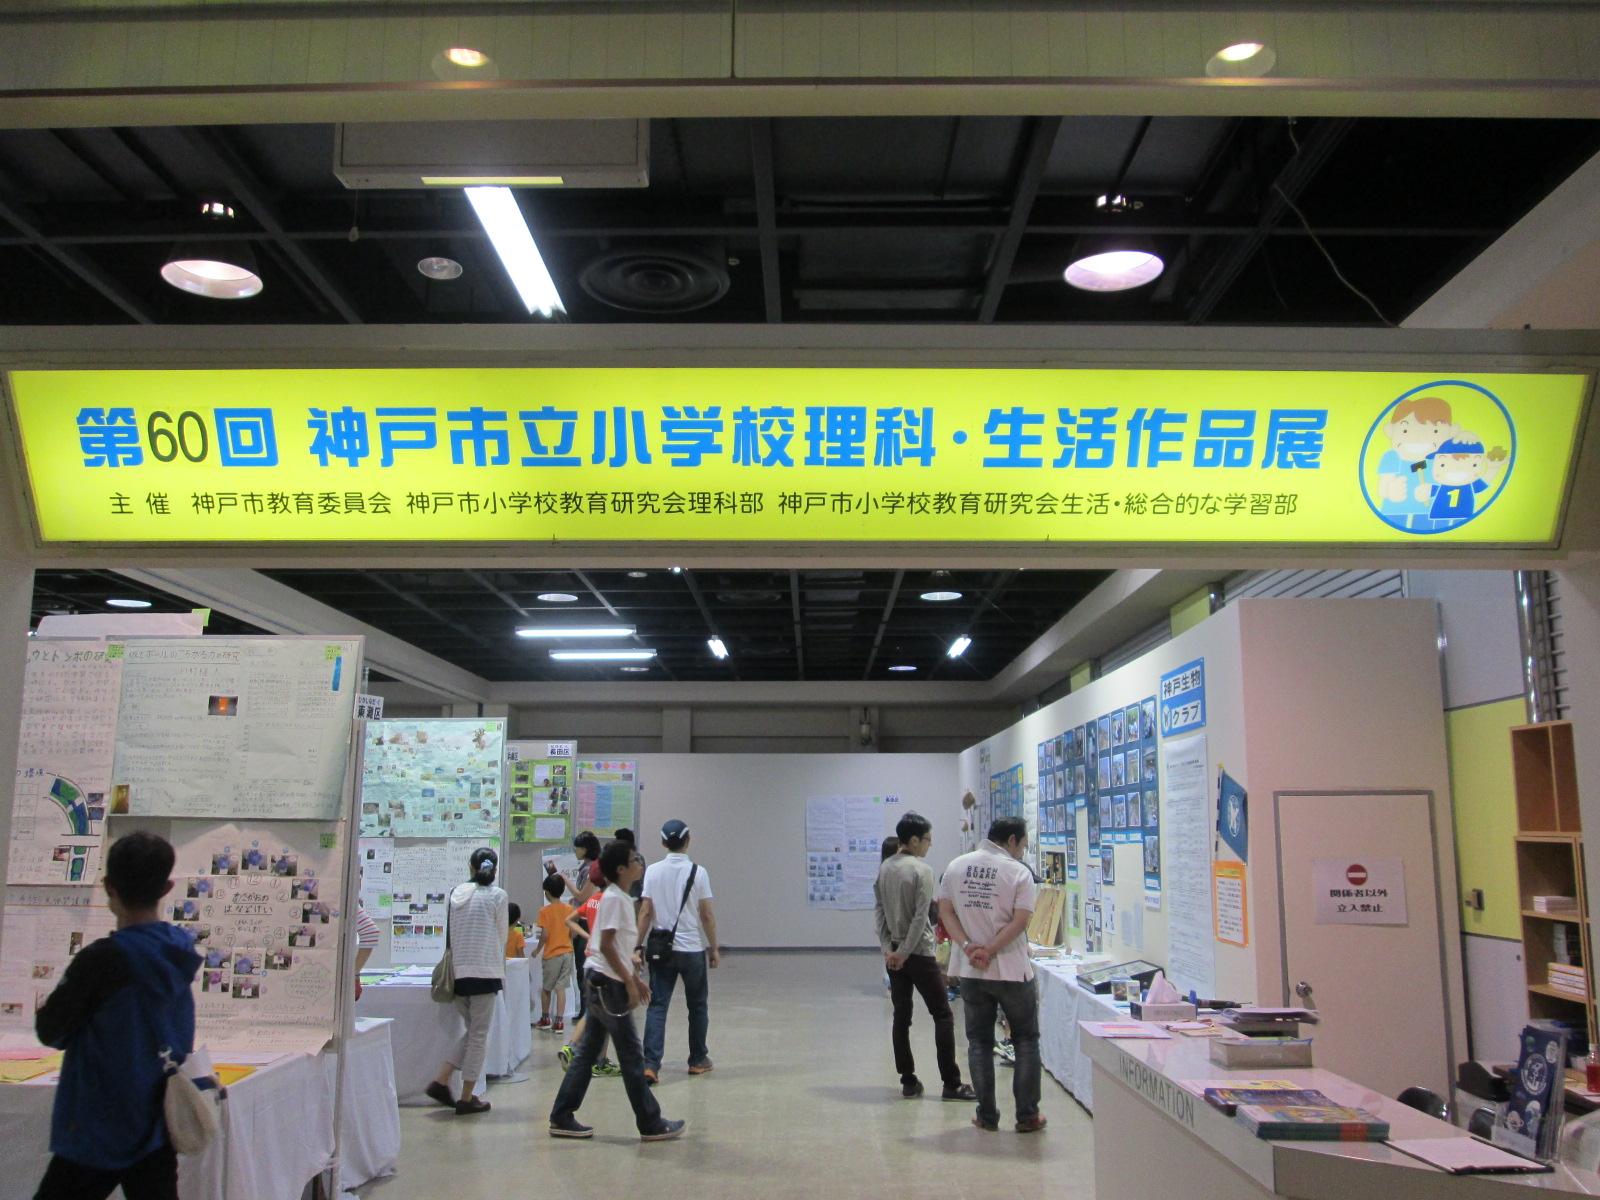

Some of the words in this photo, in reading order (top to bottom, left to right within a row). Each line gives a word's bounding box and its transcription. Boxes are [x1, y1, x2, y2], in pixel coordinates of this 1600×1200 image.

[76, 407, 279, 467] 第60回
[307, 405, 1328, 469] 神戸市立小学校理科・生活作品展
[191, 492, 391, 514] 神戸市教育委員会
[406, 491, 764, 514] 神戸市小学校教育研究会理科部
[778, 491, 1298, 516] 神戸市小学校教育研究会生活・総合的な学習部
[1447, 488, 1460, 508] 1
[1164, 669, 1201, 698] 神戸生物
[1172, 702, 1200, 726] クラブ
[967, 865, 998, 874] BEACH
[1329, 888, 1388, 898] 関係者以外
[1336, 903, 1384, 913] 立入禁止
[1119, 1055, 1195, 1129] INFORMATION
